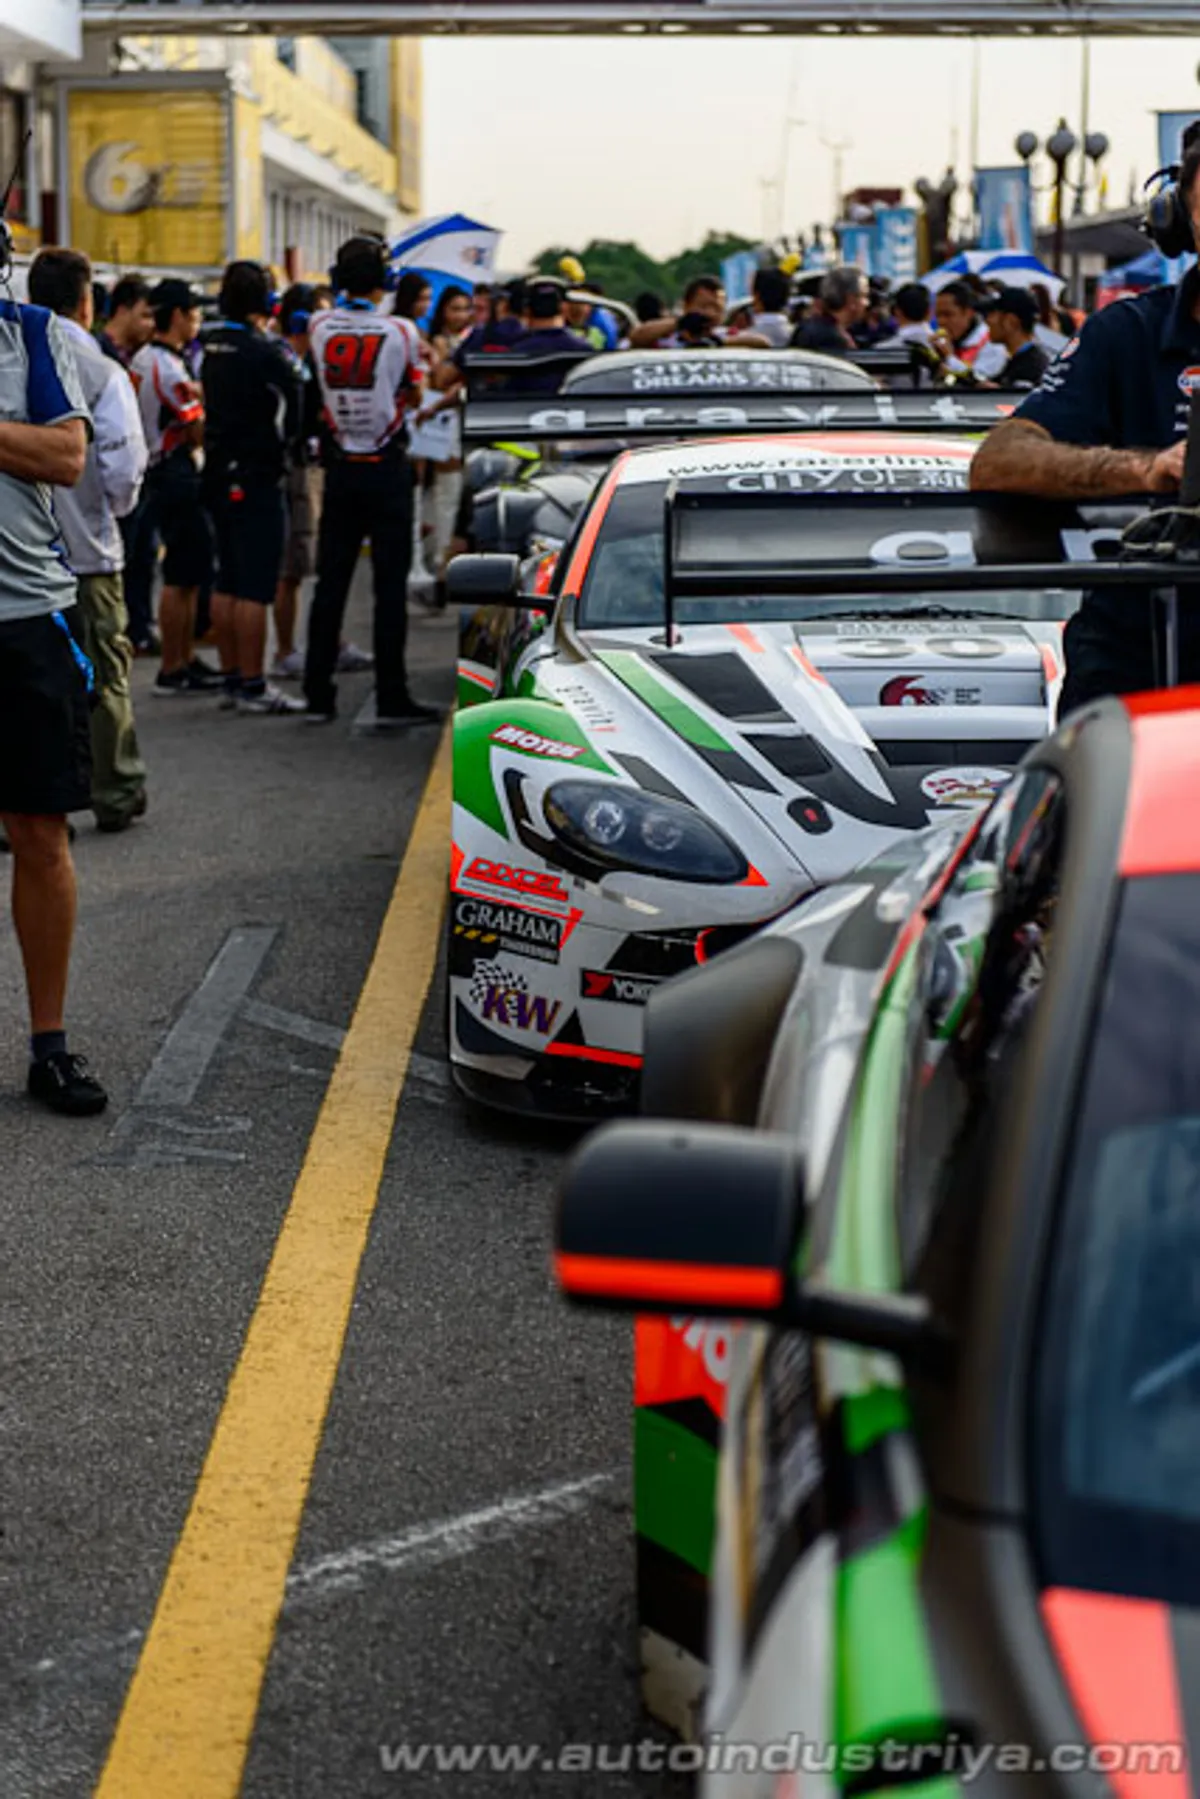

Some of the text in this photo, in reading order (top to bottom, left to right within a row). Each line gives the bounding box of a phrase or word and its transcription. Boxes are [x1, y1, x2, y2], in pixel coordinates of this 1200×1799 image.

[323, 333, 387, 391] 91
[727, 469, 842, 492] CITY
[852, 468, 907, 485] OF
[464, 857, 562, 891] DIXCEL
[456, 901, 558, 944] GRAHAM
[481, 984, 562, 1035] KW
